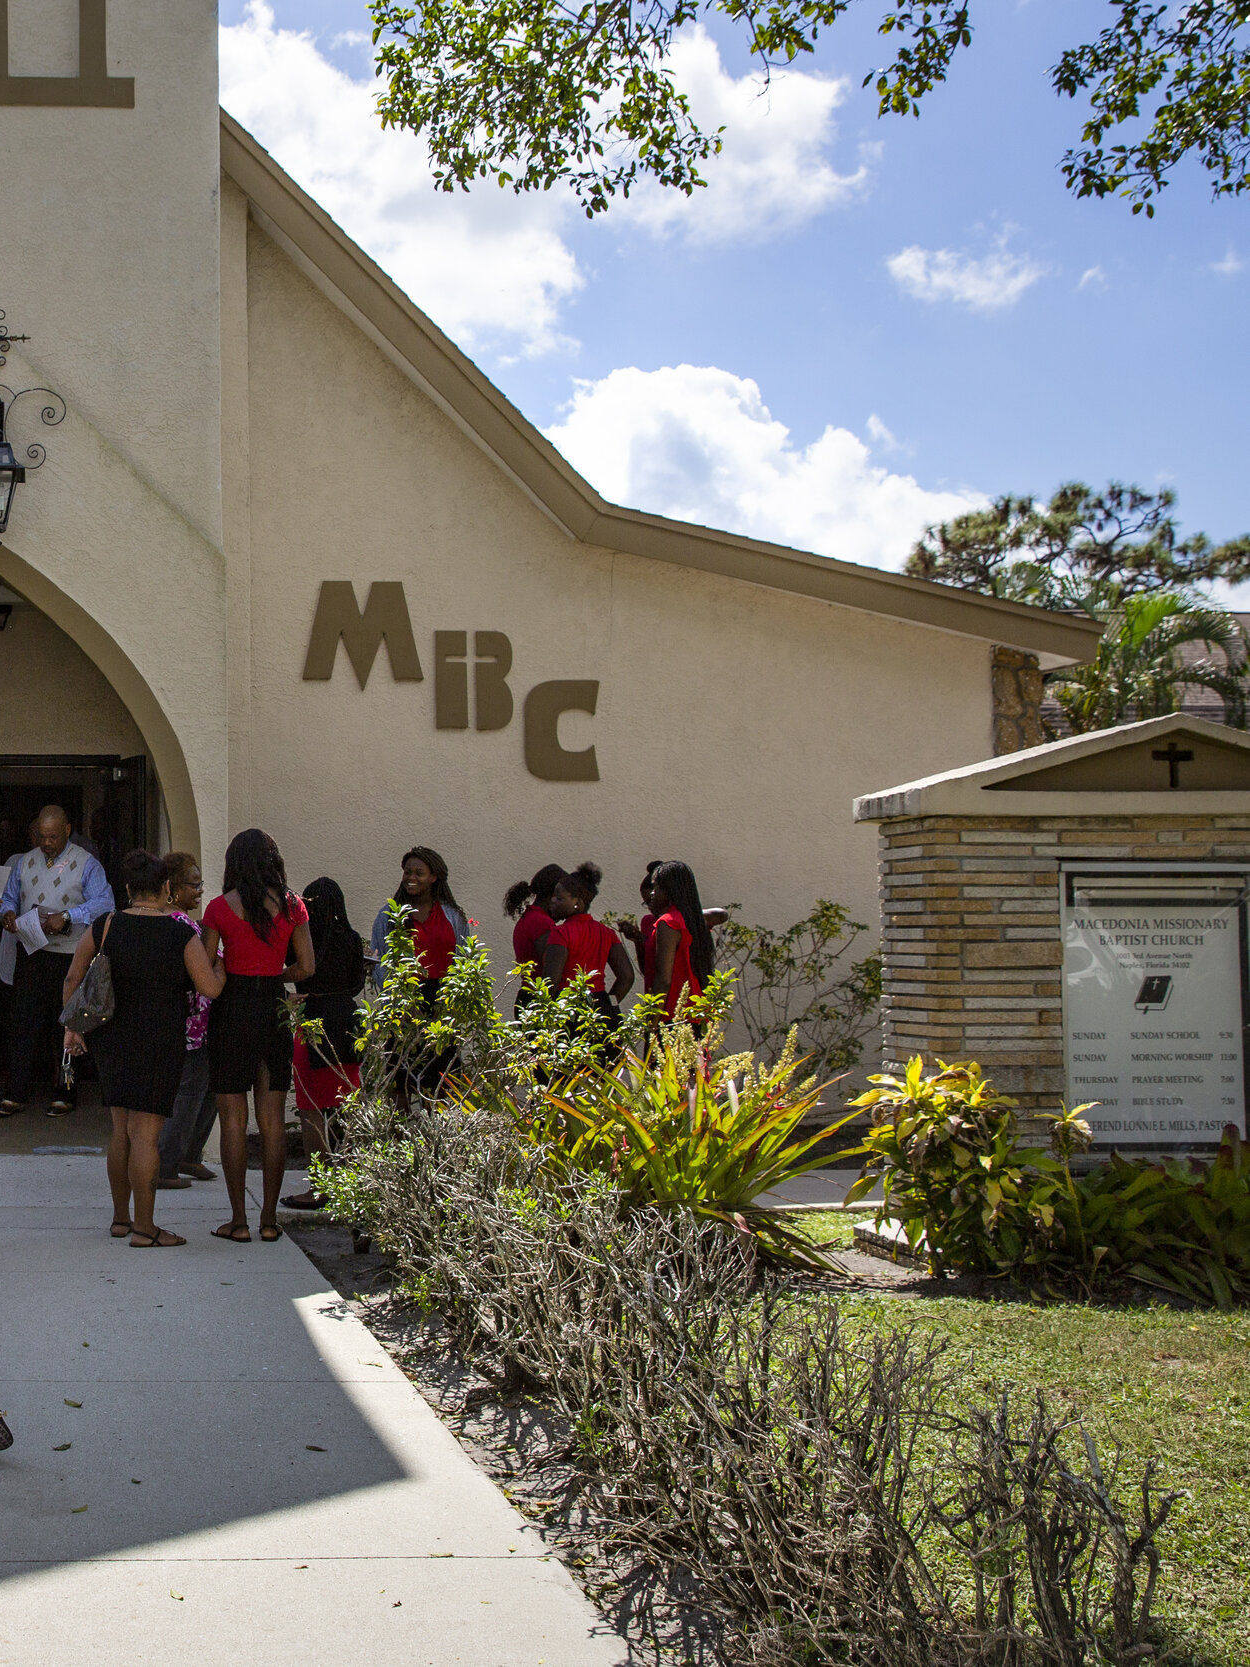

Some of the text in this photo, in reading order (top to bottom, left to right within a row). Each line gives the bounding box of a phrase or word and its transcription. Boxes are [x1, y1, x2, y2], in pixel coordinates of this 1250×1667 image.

[1074, 919, 1229, 929] MACEDONIA MISSIONARY
[1100, 935, 1204, 945] BAPTIST CHURCH
[1072, 1032, 1107, 1040] SUNDAY
[1130, 1032, 1164, 1040] SUNDAY
[1073, 1054, 1107, 1062] SUNDAY
[1175, 1053, 1213, 1061] WORSHIP
[1220, 1053, 1237, 1061] 11:00
[1074, 1076, 1118, 1084] THURSDAY
[1165, 1075, 1204, 1083] MEETING
[1132, 1098, 1154, 1106] BIBLE
[1123, 1120, 1158, 1131] LONNIE
[1159, 1120, 1167, 1131] E.
[1169, 1120, 1197, 1132] MILLS,
